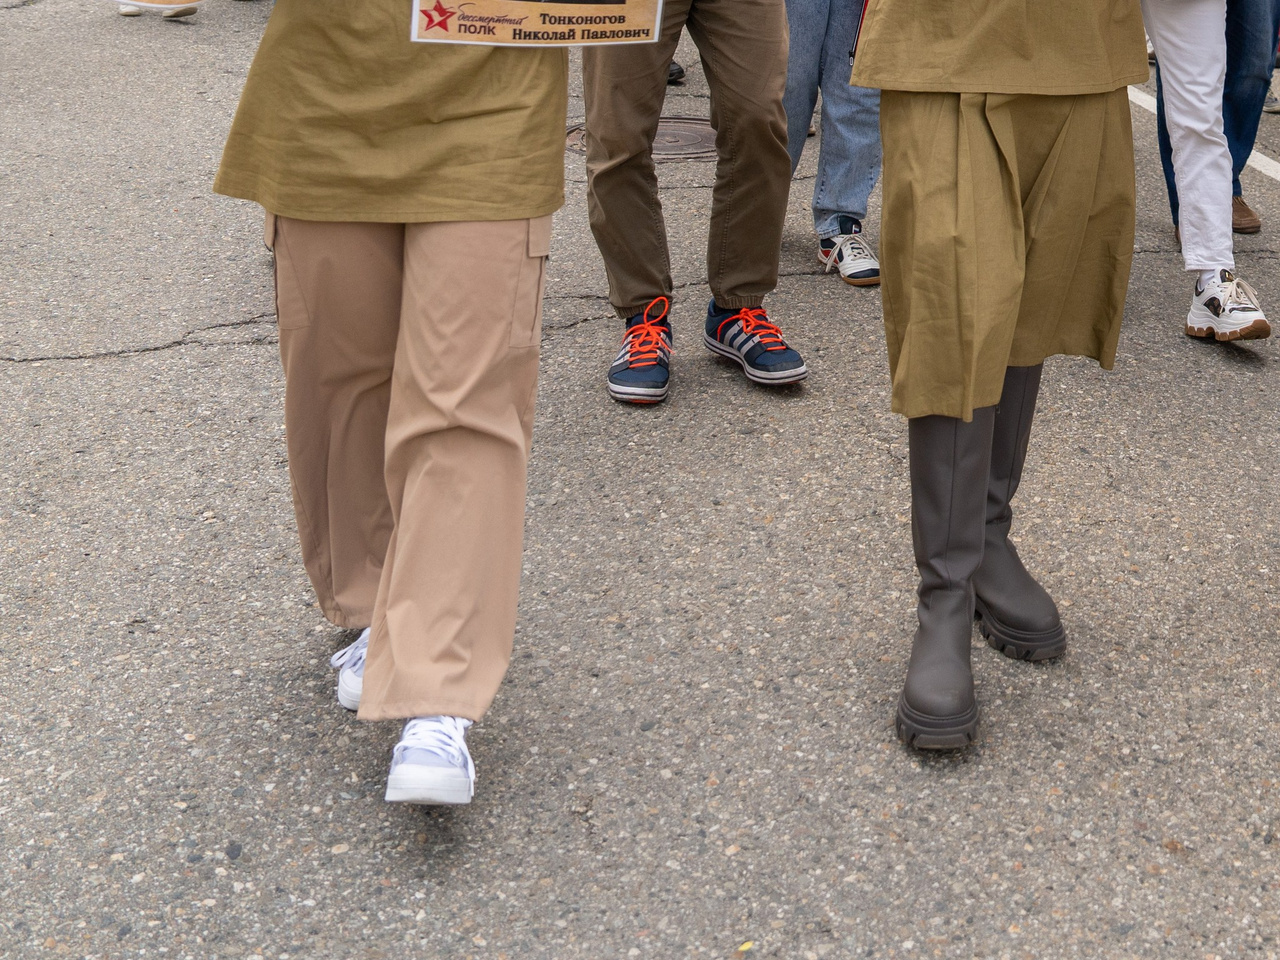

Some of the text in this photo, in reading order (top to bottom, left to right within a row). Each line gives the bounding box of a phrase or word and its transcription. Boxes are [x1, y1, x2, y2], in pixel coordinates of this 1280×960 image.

[539, 13, 626, 26] Тонконогов
[457, 23, 497, 36] ПОЛК
[511, 27, 651, 41] Николай Павлович
